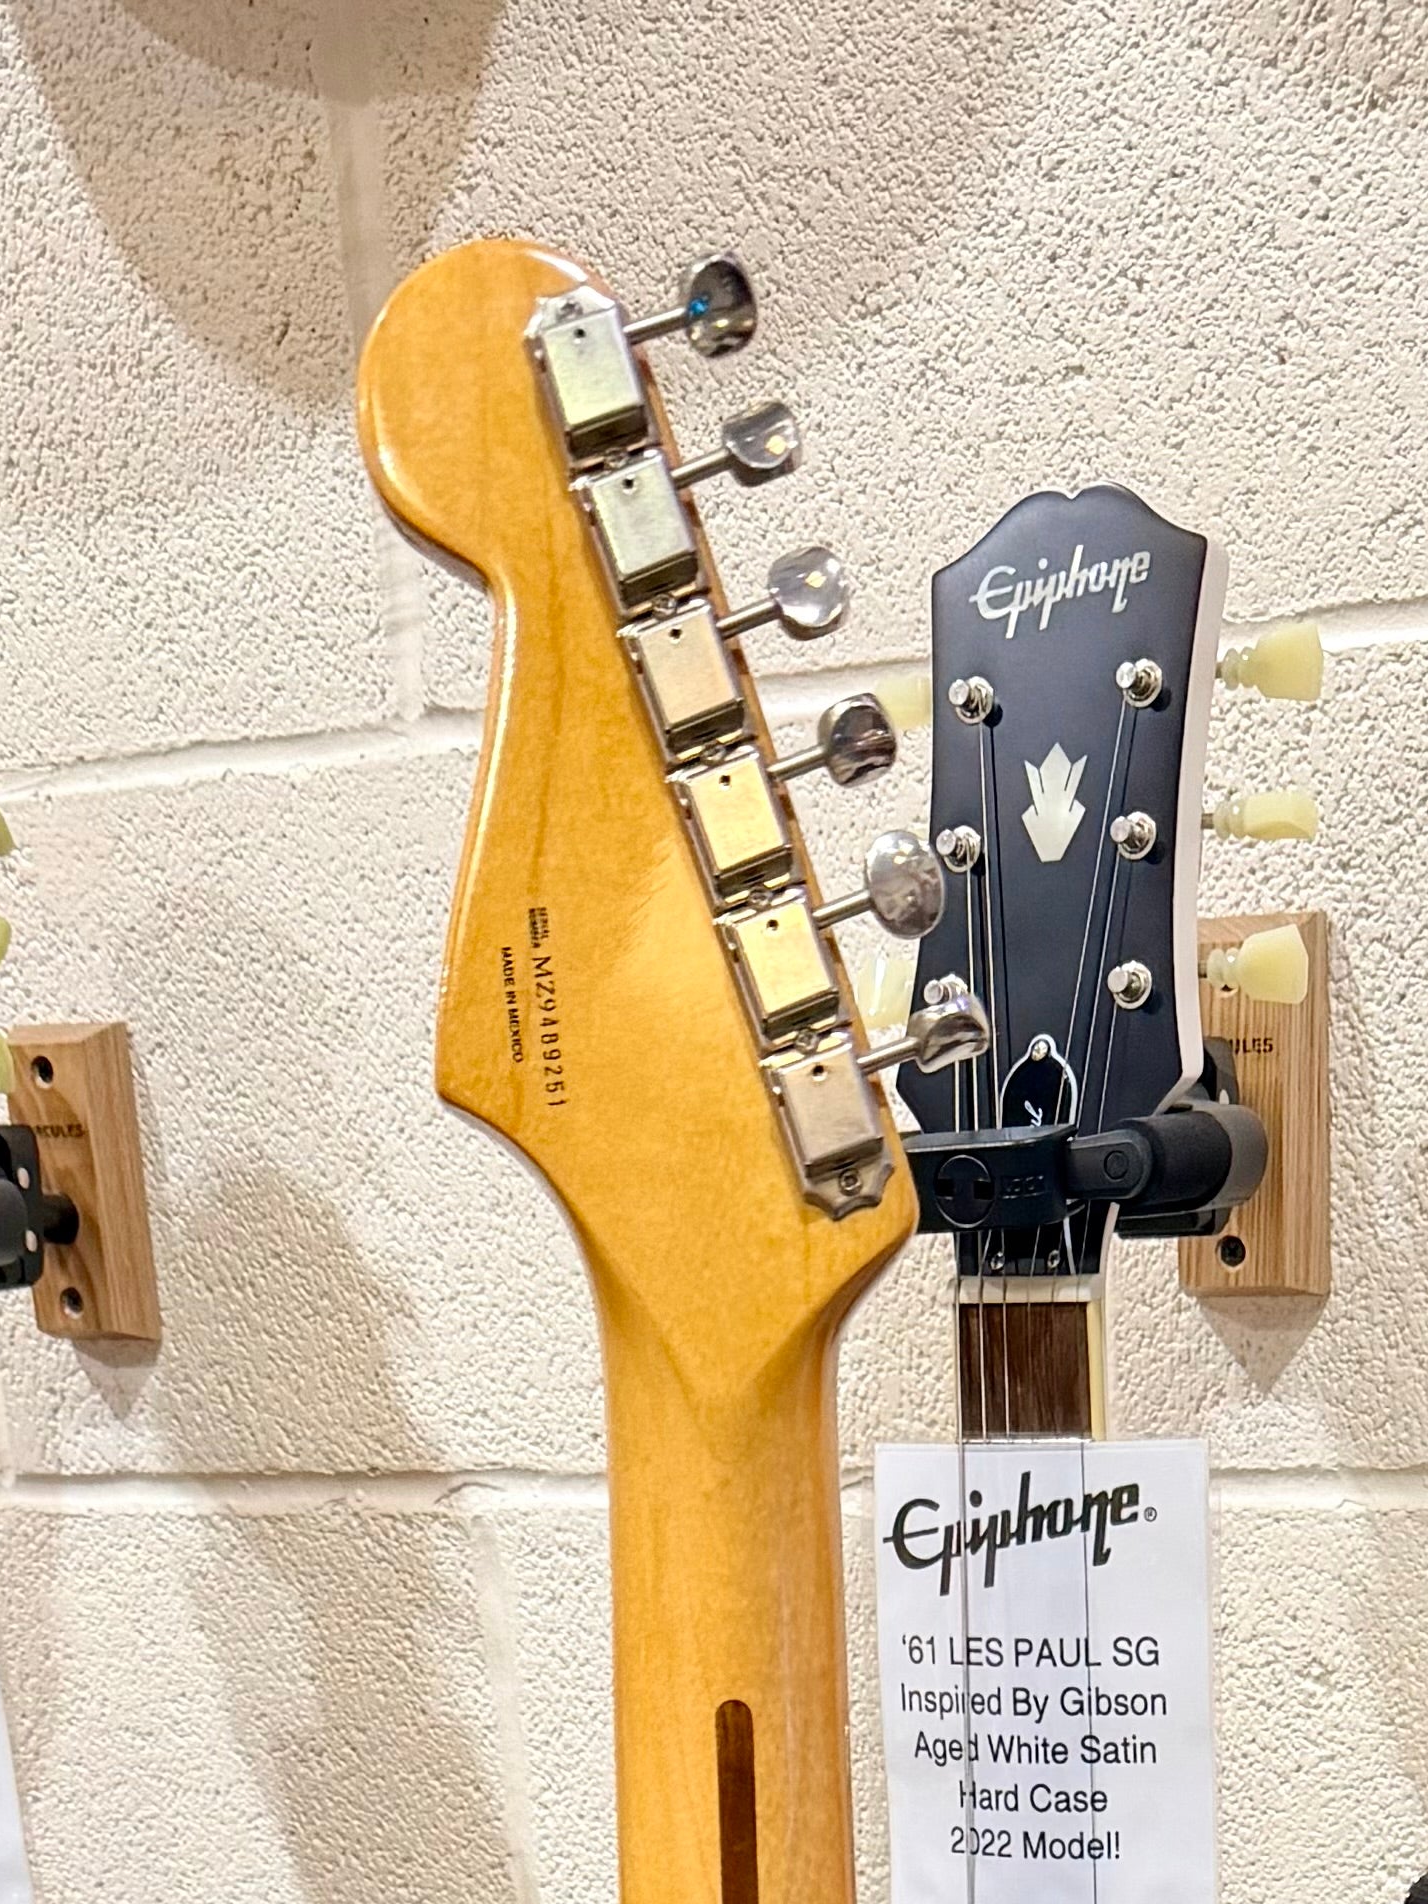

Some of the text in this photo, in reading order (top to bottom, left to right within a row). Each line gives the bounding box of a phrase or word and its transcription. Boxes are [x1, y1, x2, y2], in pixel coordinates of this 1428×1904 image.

[969, 543, 1150, 639] Epiphone
[501, 946, 524, 1063] MADE IN MEXICO
[883, 1471, 1140, 1596] Epiphone
[949, 1636, 1005, 1667] LES
[1013, 1636, 1102, 1668] PAUL
[1112, 1636, 1160, 1668] SG
[900, 1684, 1168, 1724] Inspired By Gibson
[914, 1731, 1157, 1767] Aged White Satin
[959, 1781, 1108, 1814] Hard Case
[950, 1826, 1121, 1862] 2022 Model!
